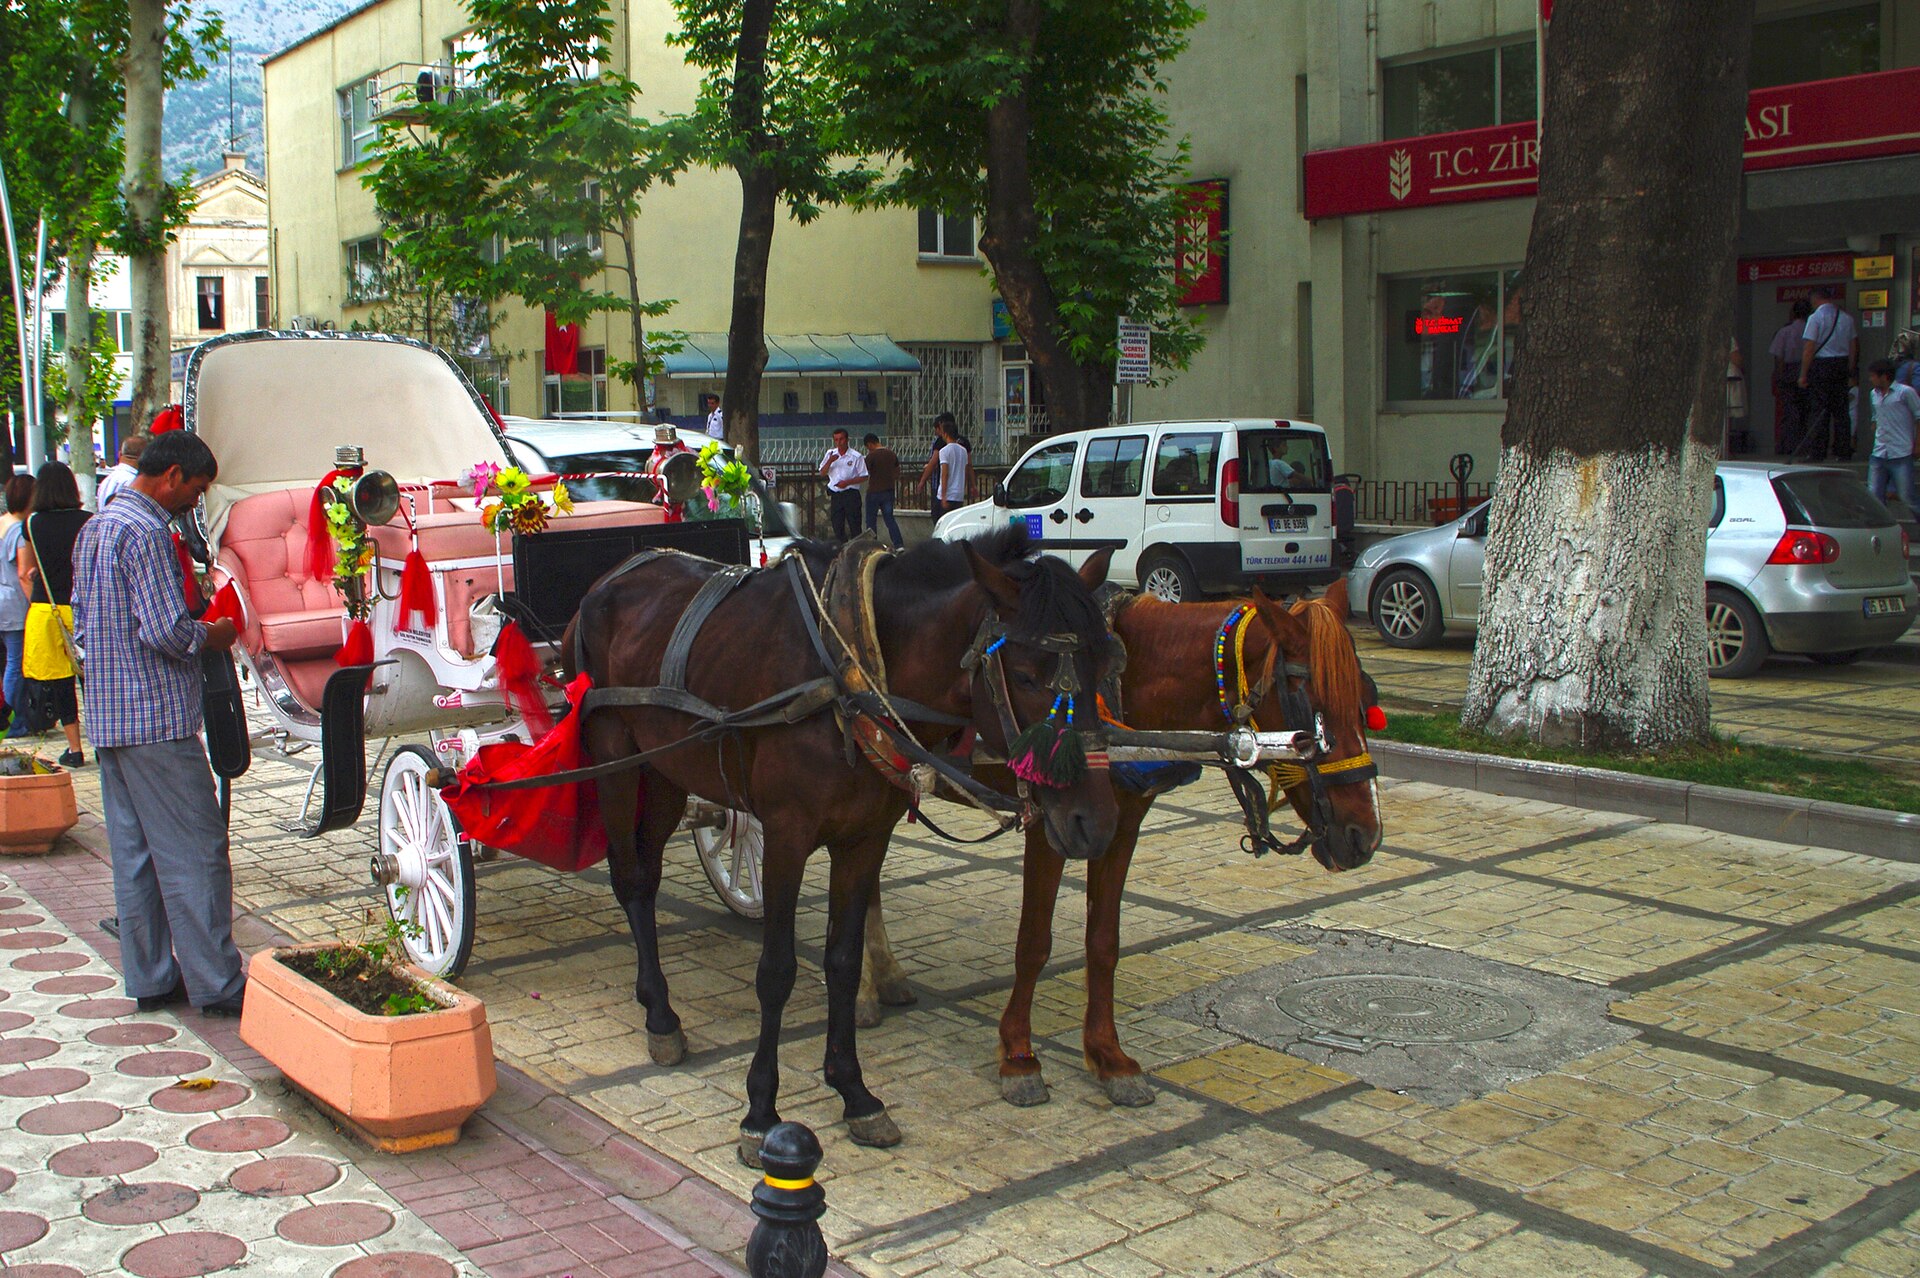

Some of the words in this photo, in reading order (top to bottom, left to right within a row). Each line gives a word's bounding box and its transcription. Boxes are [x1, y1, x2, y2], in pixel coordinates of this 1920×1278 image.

[1429, 146, 1479, 179] T.C.
[1488, 135, 1539, 172] ZİR
[1778, 263, 1804, 276] SELF
[1246, 556, 1263, 565] TÜRK
[1264, 556, 1290, 565] TELEKOM
[1291, 555, 1307, 565] 444
[1314, 554, 1327, 564] 444
